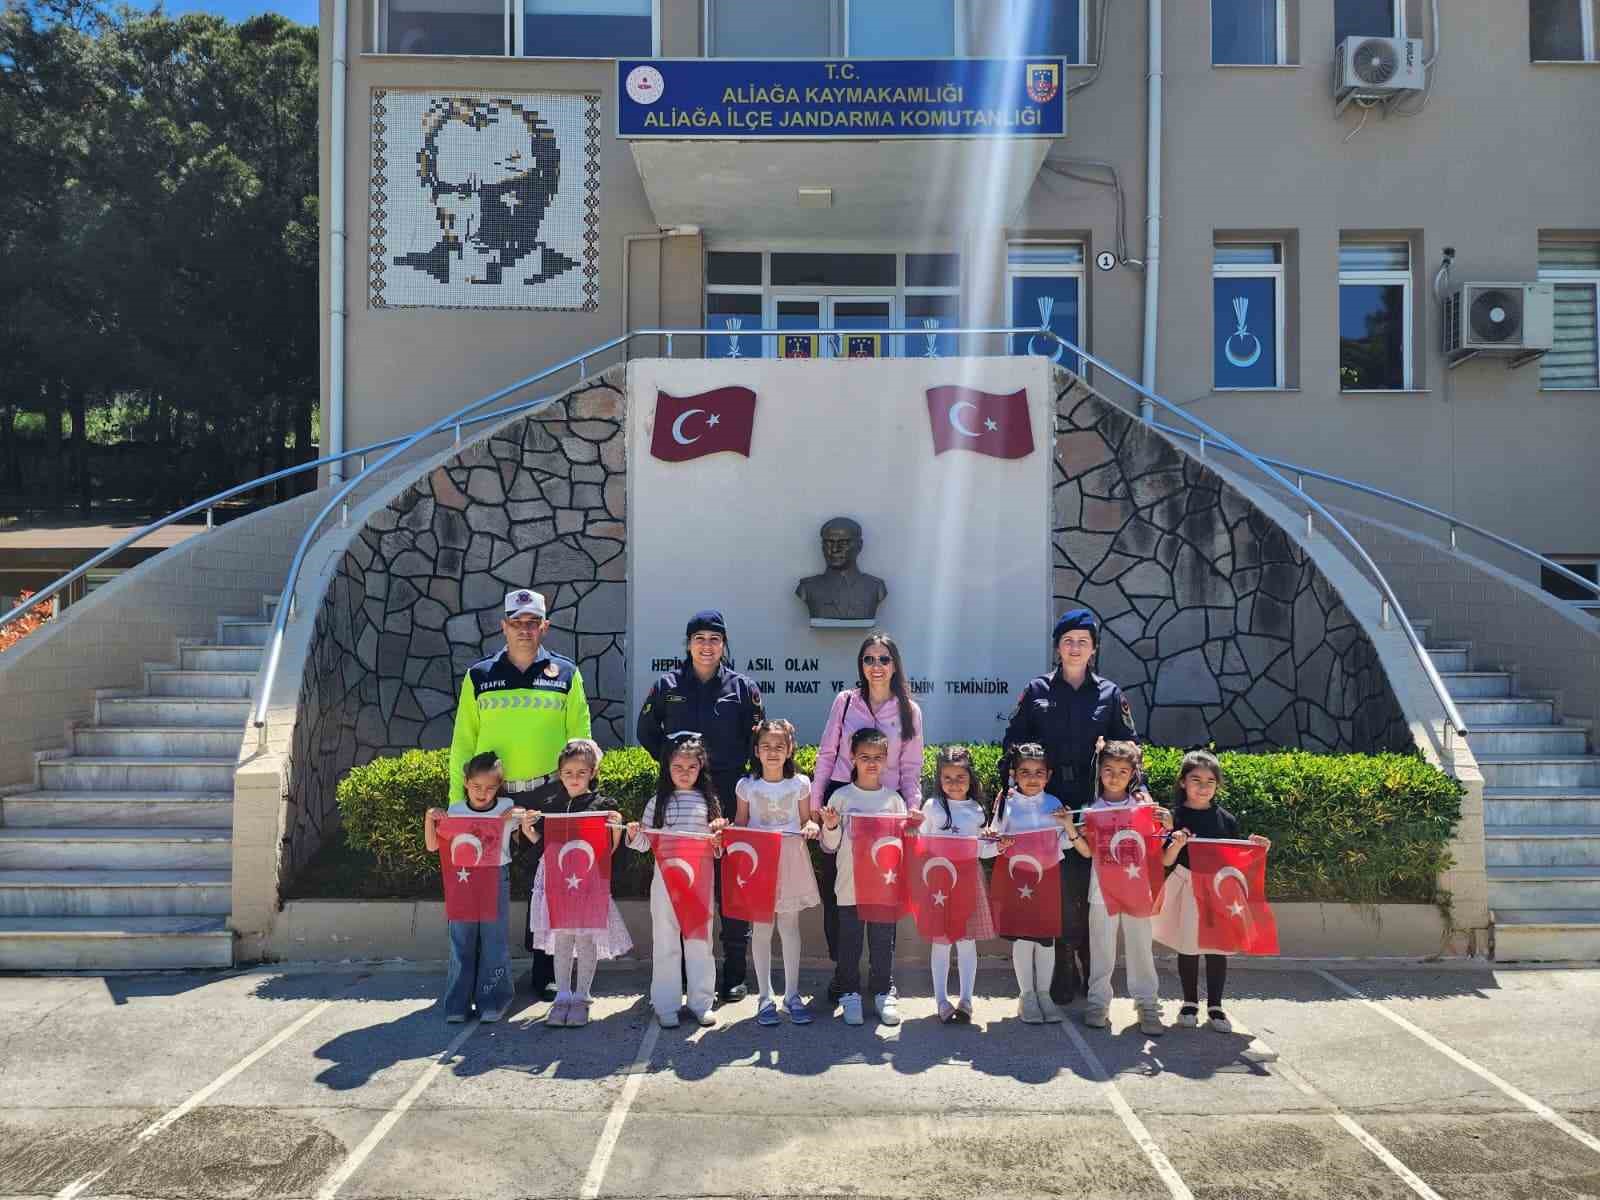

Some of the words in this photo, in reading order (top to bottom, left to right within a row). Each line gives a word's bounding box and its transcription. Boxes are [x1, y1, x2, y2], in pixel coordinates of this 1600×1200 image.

[824, 64, 860, 80] T.C.
[722, 84, 800, 104] ALİAĞA
[806, 83, 964, 104] KAYMAKAMLIĞI
[643, 107, 722, 128] ALİAĞA
[727, 107, 773, 130] İLÇE
[779, 111, 895, 128] JANDARMA
[901, 106, 1041, 127] KOMUTANLIĞI
[747, 659, 774, 672] ASIL
[785, 658, 819, 672] OLAN
[785, 681, 821, 694] HAYAT
[944, 677, 1009, 694] TEMİNİDİR
